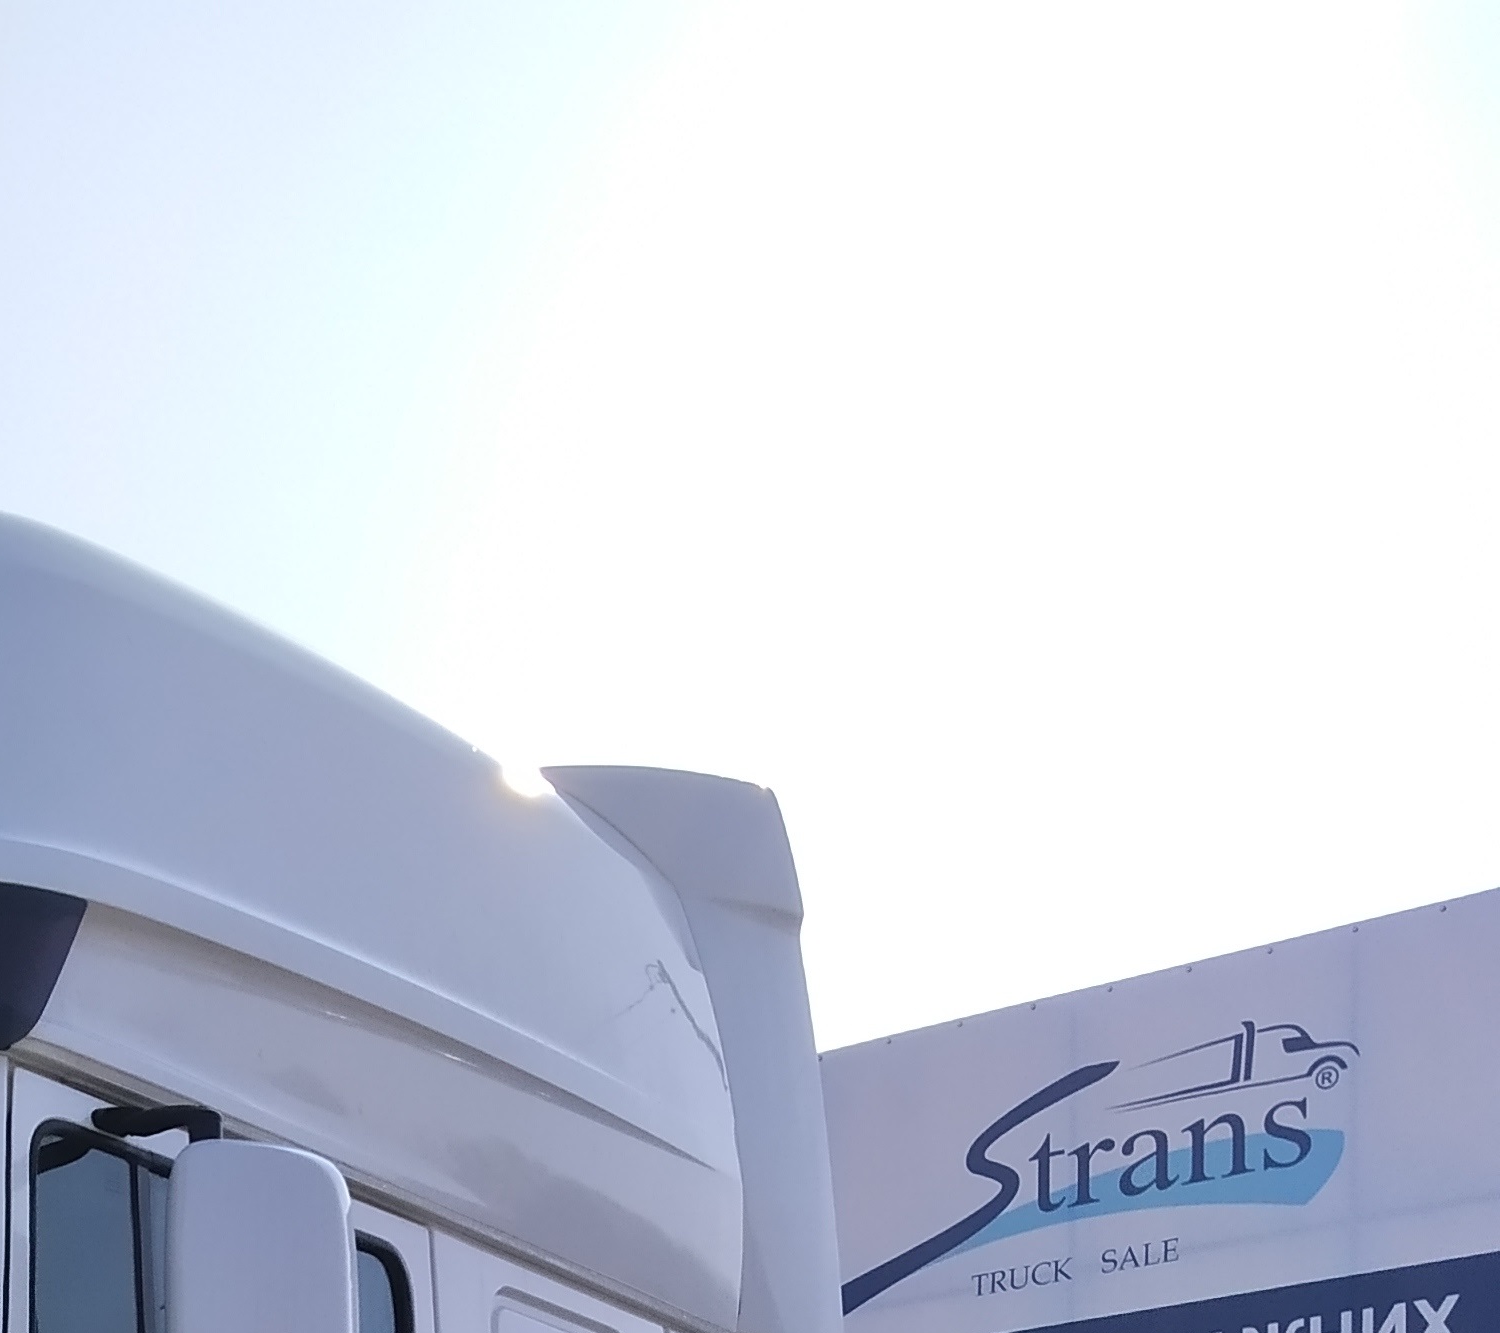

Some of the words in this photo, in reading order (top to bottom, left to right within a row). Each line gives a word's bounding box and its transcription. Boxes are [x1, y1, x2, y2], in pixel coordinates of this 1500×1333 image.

[842, 1060, 1314, 1316] Strans
[971, 1257, 1073, 1298] TRUCK
[1100, 1237, 1180, 1276] SALE
